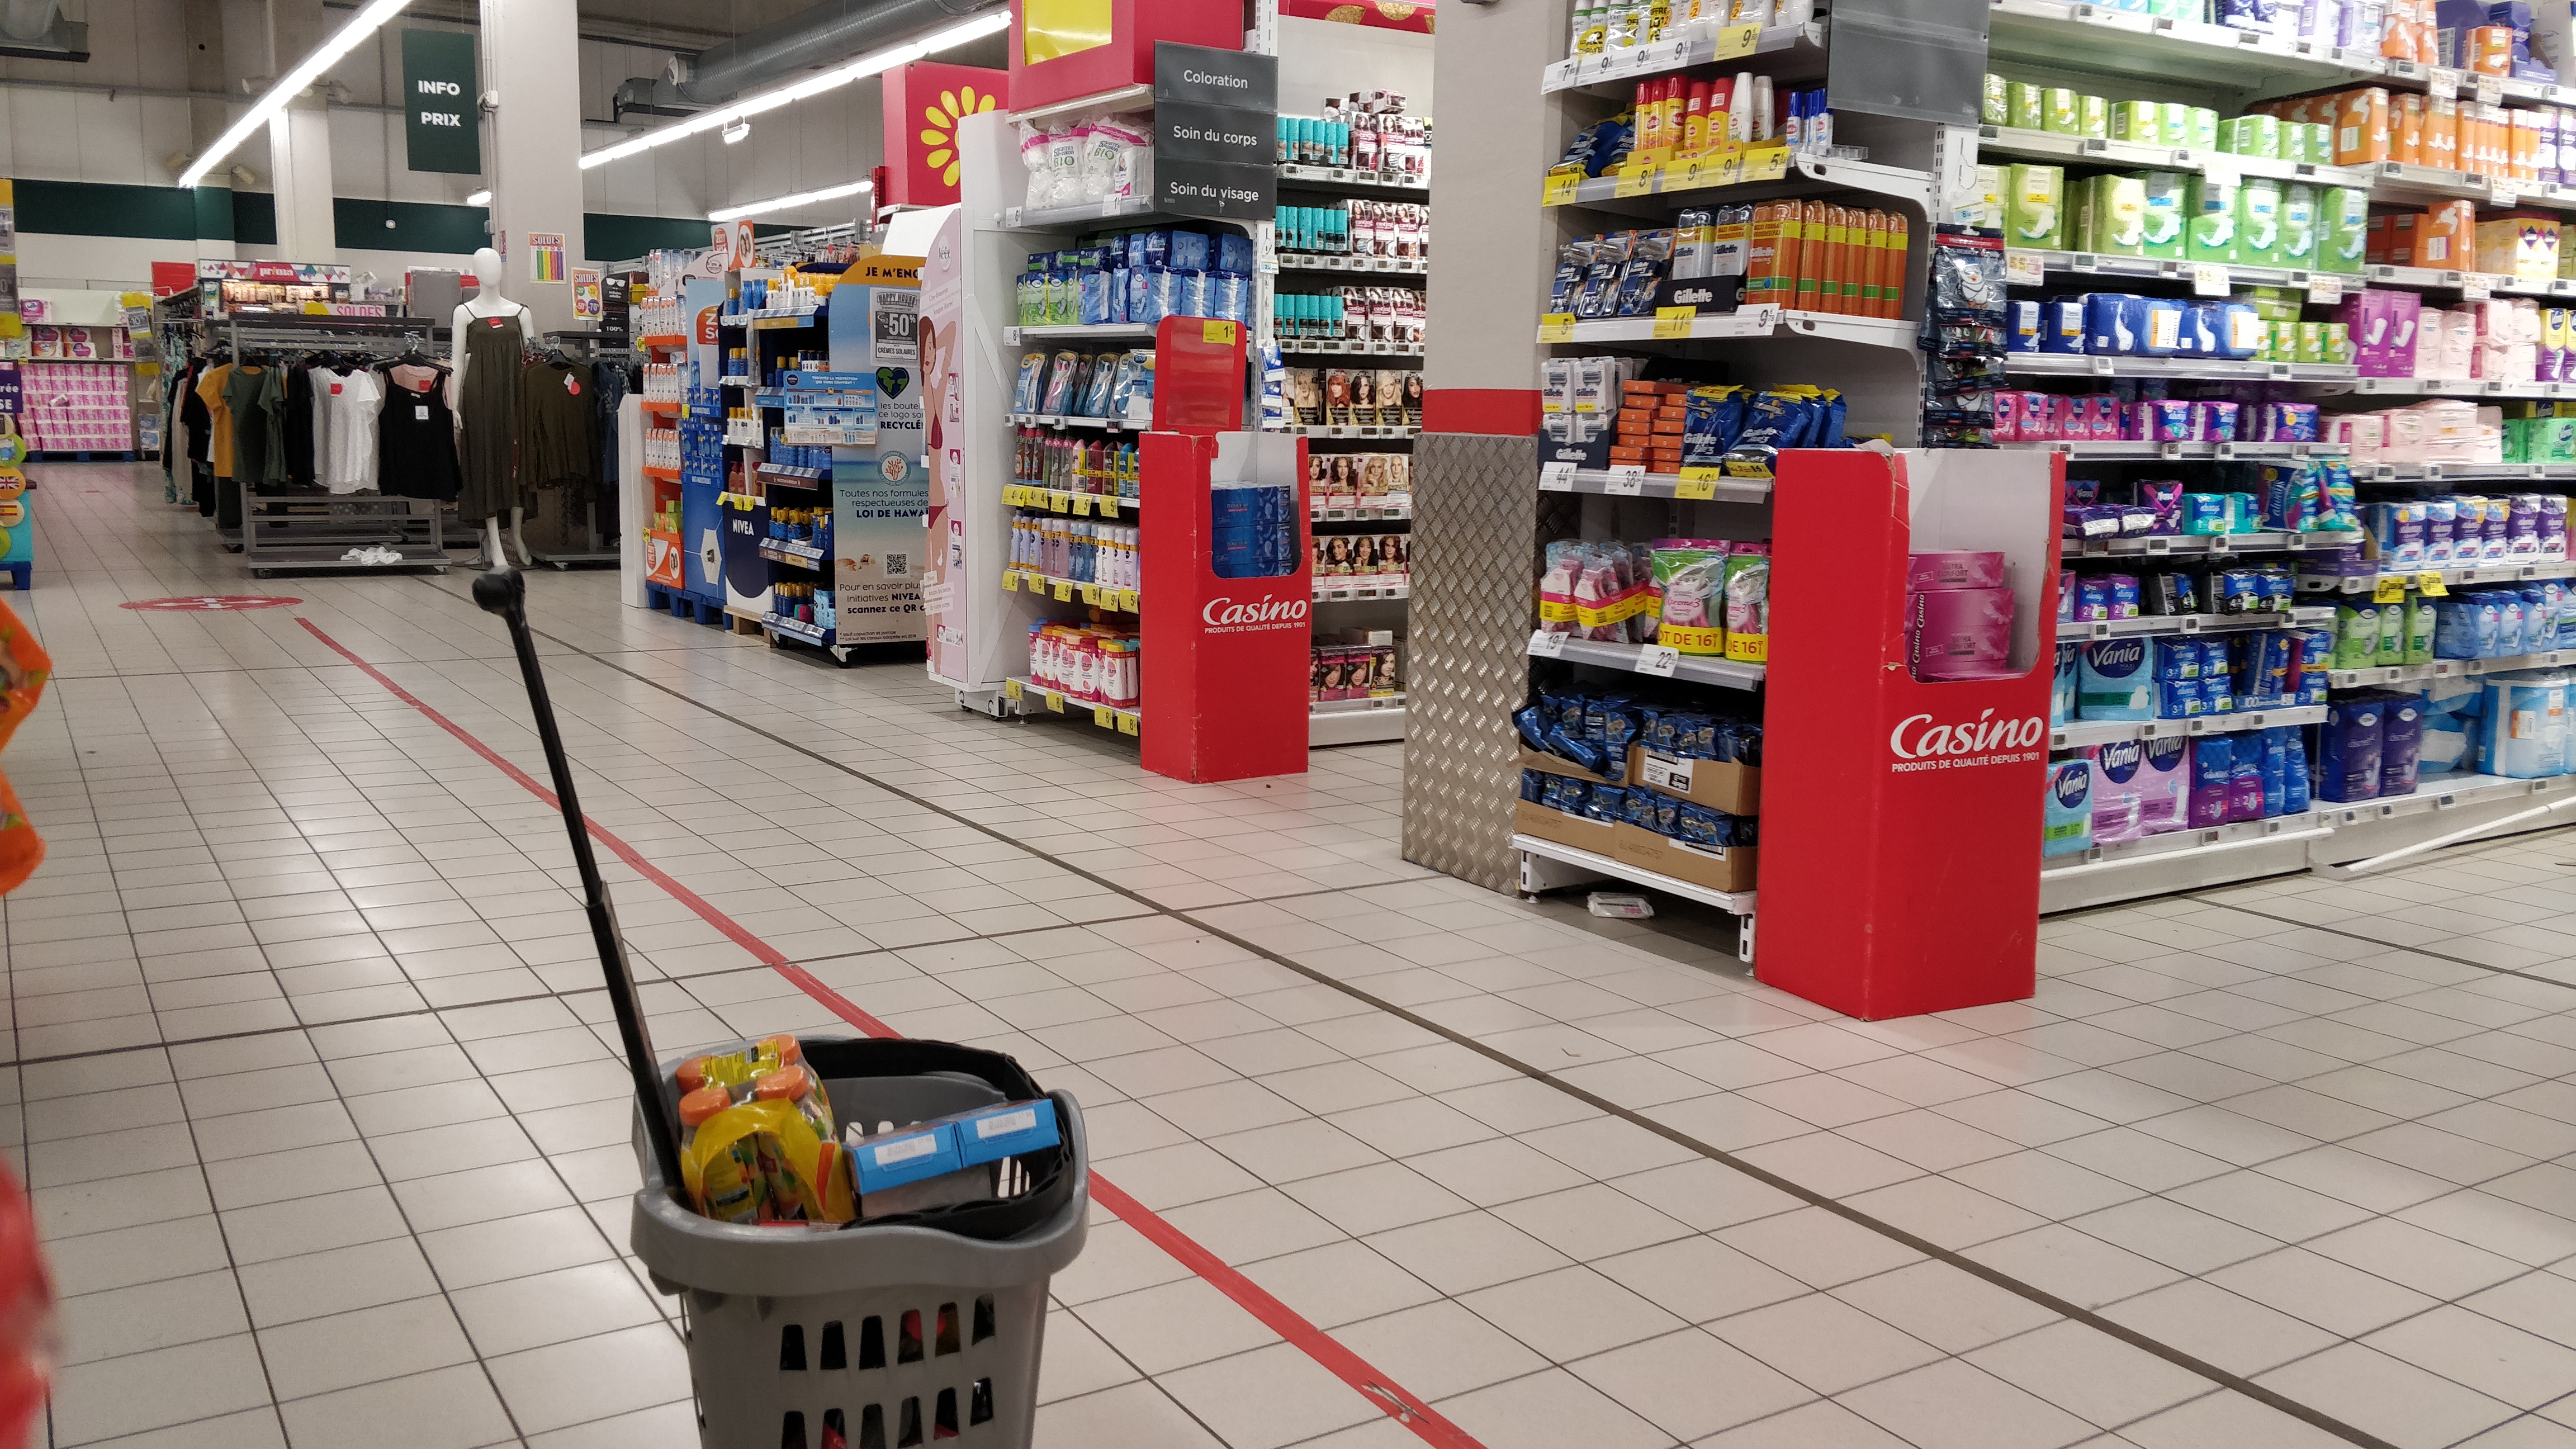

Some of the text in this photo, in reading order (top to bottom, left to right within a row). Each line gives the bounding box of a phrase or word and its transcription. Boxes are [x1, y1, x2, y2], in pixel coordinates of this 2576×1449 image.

[1183, 69, 1248, 89] Coloration
[418, 80, 461, 96] INFO
[420, 112, 461, 127] PRIX
[1173, 125, 1258, 148] Soin du corps
[1093, 148, 1115, 160] BIO
[1054, 155, 1075, 168] BIO
[1169, 182, 1259, 202] Soin du visage
[533, 236, 560, 245] SOLDES
[1714, 244, 1738, 254] Gillette
[574, 273, 598, 283] SOLDES
[865, 267, 878, 277] JE
[1674, 288, 1713, 304] Gillette
[336, 305, 383, 318] SOLDES
[883, 313, 917, 337] -50%
[896, 347, 916, 356] SOLAIRES
[891, 411, 911, 420] logo
[1684, 433, 1717, 445] Gillette
[1556, 448, 1587, 461] Gillette
[839, 489, 870, 498] Toutes
[891, 489, 929, 498] formules
[851, 499, 915, 508] respectueuses
[856, 509, 874, 518] LOI
[878, 509, 891, 518] DE
[732, 518, 755, 537] NIVEA
[876, 582, 903, 590] savoir
[847, 593, 921, 603] initiatives NIVEA
[847, 605, 887, 614] scannez
[903, 604, 917, 614] QR
[1202, 594, 1307, 626] Casino
[1916, 594, 1925, 628] Casino
[1204, 626, 1235, 634] PRODUITS
[1246, 623, 1271, 632] QUALITÉ
[1673, 632, 1693, 646] DE
[1696, 634, 1712, 646] 16
[1741, 641, 1757, 654] 16
[1912, 629, 1921, 664] Casino
[2091, 639, 2142, 667] Vania
[1655, 651, 1672, 669] 22
[1890, 707, 2043, 759] Casino
[1892, 751, 2040, 773] PRODUITS DE QUALITÉ DEPUIS 1901
[2104, 741, 2141, 770] Vania
[2058, 770, 2088, 799] Vania
